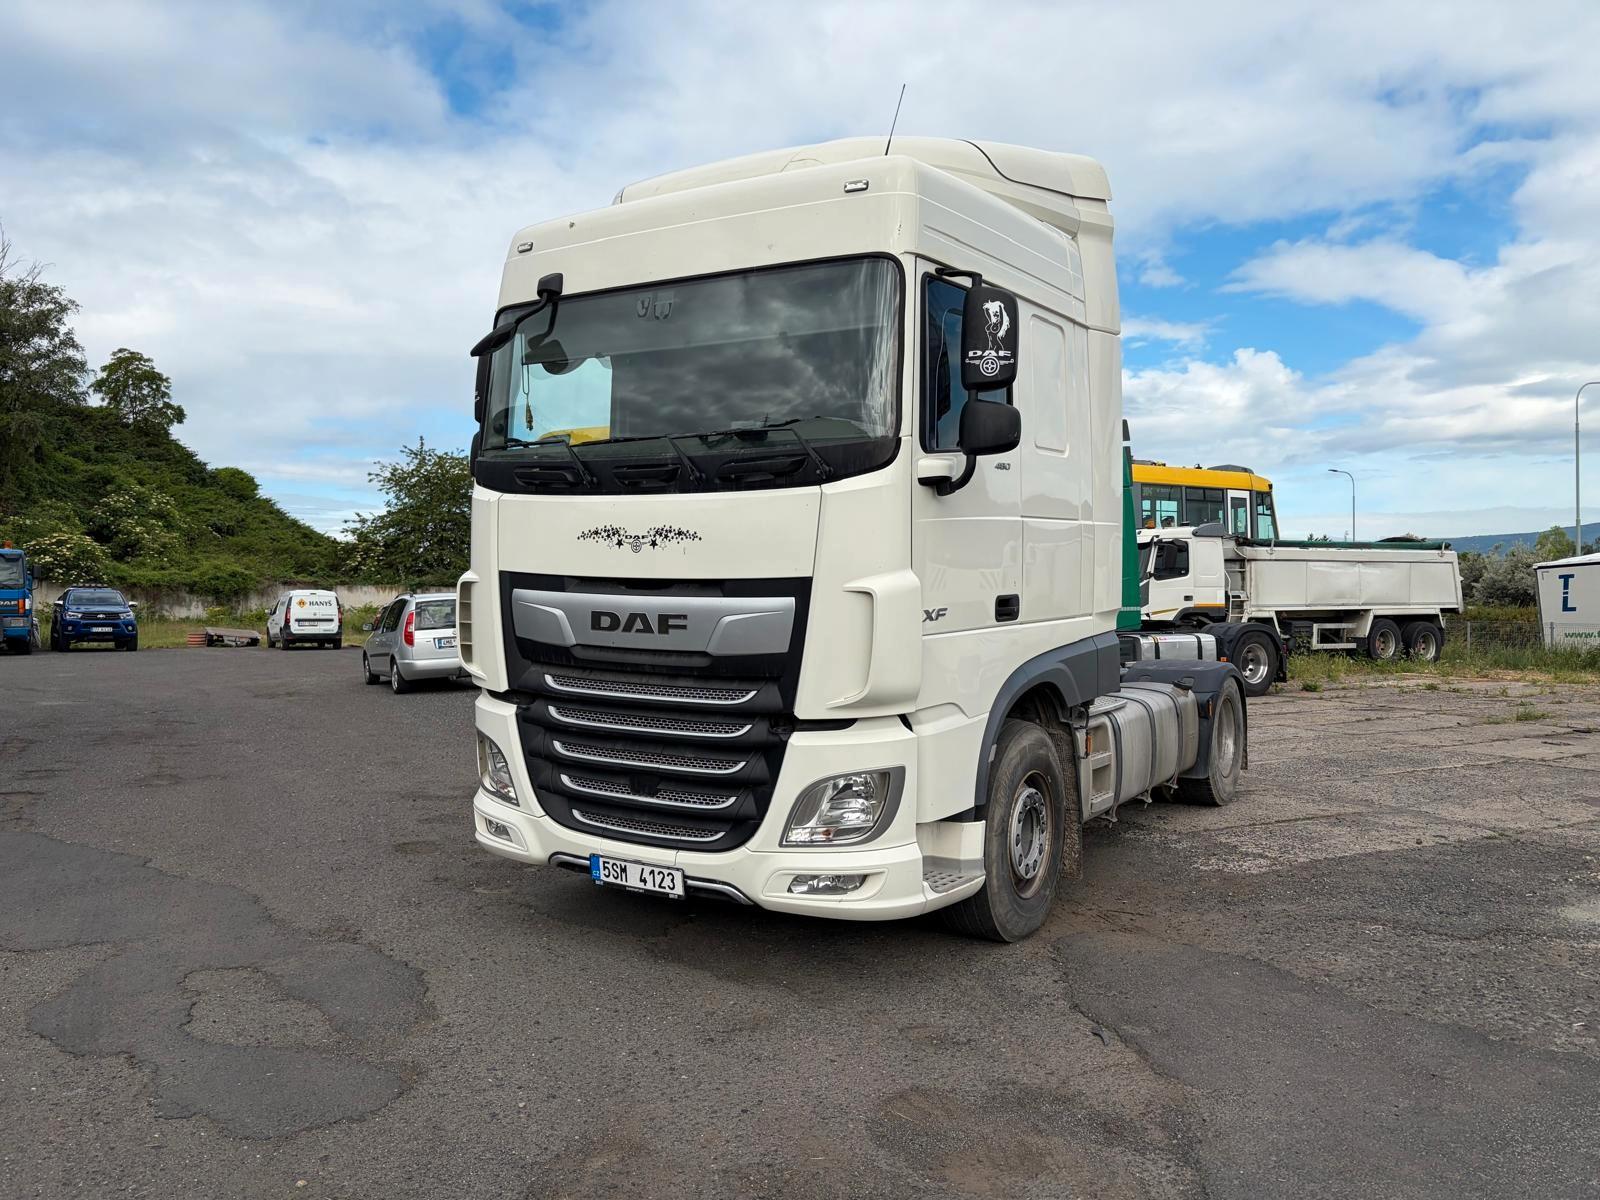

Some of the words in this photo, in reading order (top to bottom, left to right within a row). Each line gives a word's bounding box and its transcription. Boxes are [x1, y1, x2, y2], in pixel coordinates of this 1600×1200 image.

[590, 610, 688, 635] DAF
[922, 607, 948, 622] XF
[602, 861, 628, 883] 5SM
[640, 867, 676, 891] 4123
